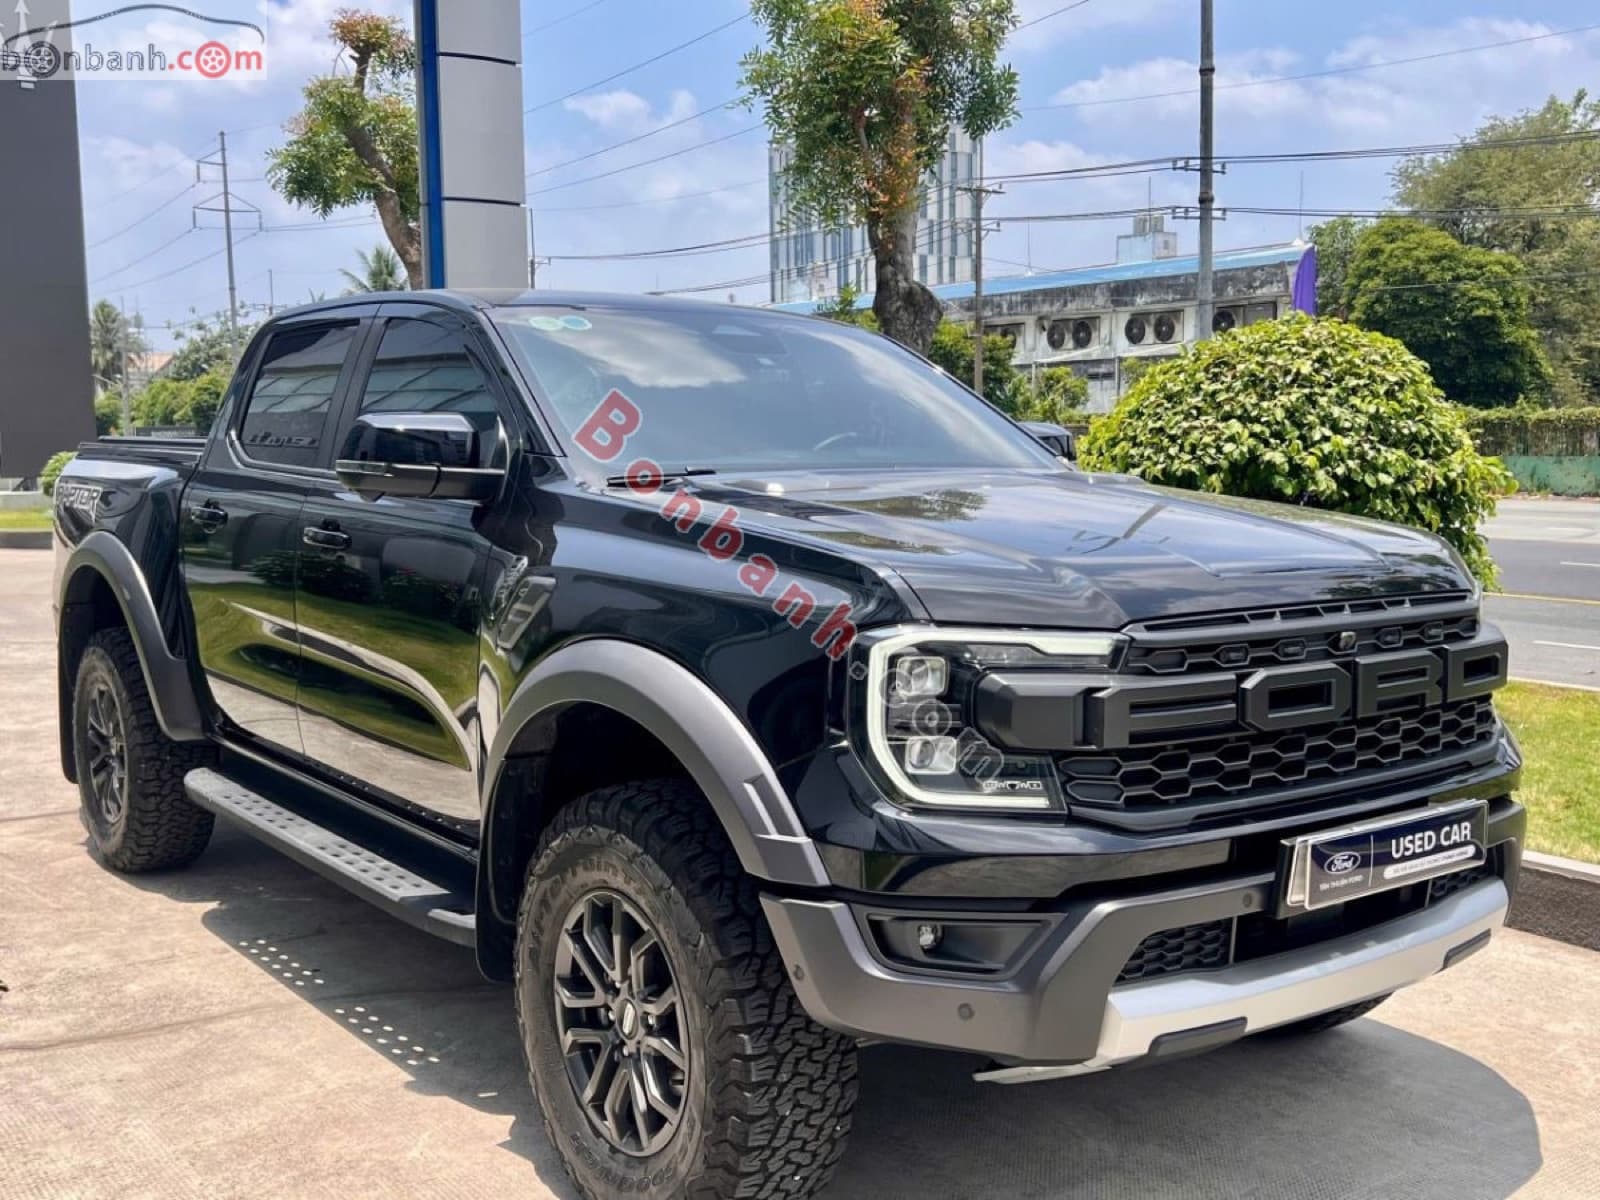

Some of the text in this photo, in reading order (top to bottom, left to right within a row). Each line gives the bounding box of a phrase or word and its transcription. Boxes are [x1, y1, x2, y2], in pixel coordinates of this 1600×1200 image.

[1095, 641, 1508, 750] FORD
[1391, 821, 1471, 858] USED CAR
[1329, 854, 1356, 872] Ford
